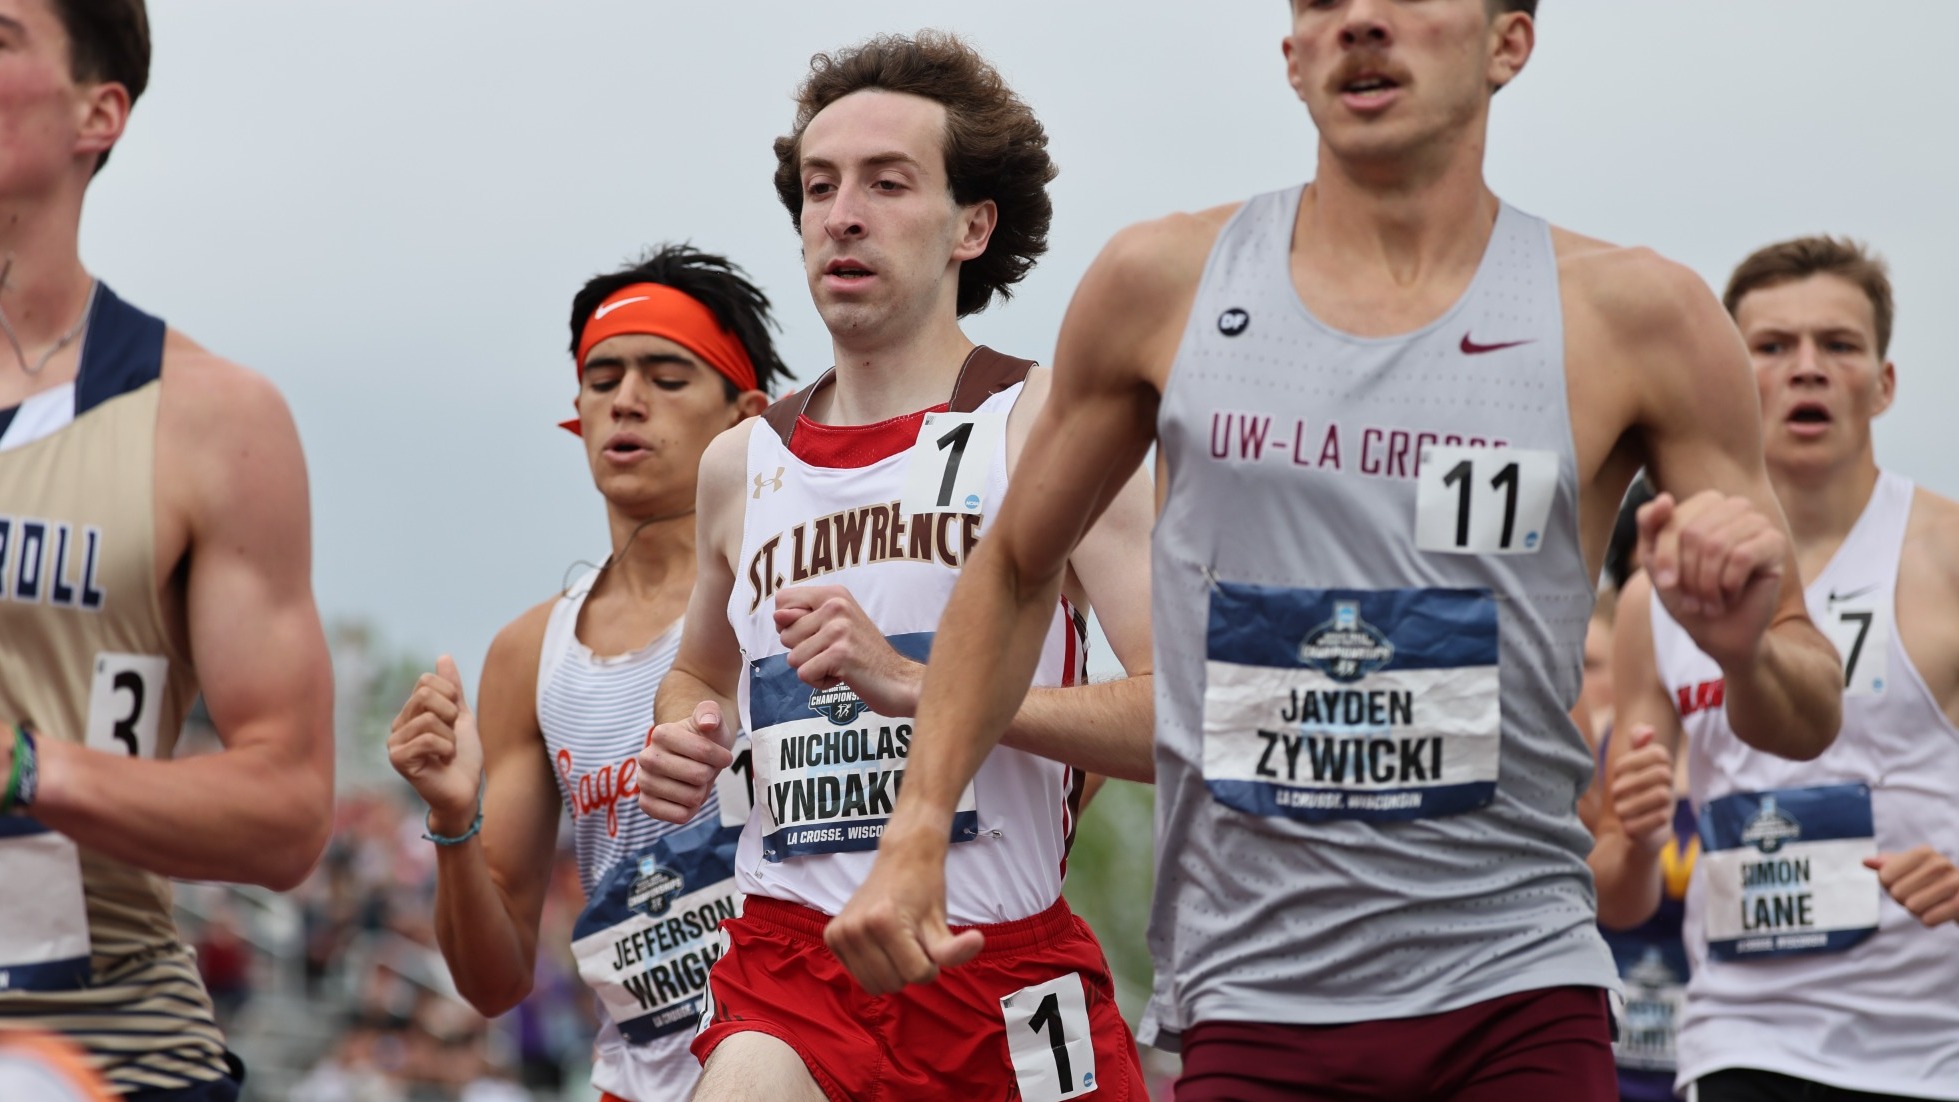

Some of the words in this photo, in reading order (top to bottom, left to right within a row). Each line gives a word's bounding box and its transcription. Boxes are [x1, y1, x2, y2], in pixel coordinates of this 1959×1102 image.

[936, 422, 975, 507] 1
[1209, 411, 1342, 471] UW-LA
[1442, 459, 1520, 550] 11
[747, 532, 786, 616] ST.
[789, 499, 984, 585] LAWRENCE
[1840, 611, 1873, 688] 7
[113, 670, 145, 759] 3
[811, 691, 861, 706] CHAMPIONS
[1281, 689, 1413, 725] JAYDEN
[780, 724, 913, 771] NICHOLAS
[1256, 730, 1443, 784] ZYWICKI
[557, 742, 647, 838] Sage
[786, 831, 798, 845] LA
[800, 828, 845, 844] CROSSE,
[1741, 856, 1811, 888] SIMON
[612, 895, 737, 971] JEFFERSON
[1742, 893, 1814, 931] LANE
[1028, 992, 1074, 1095] 1
